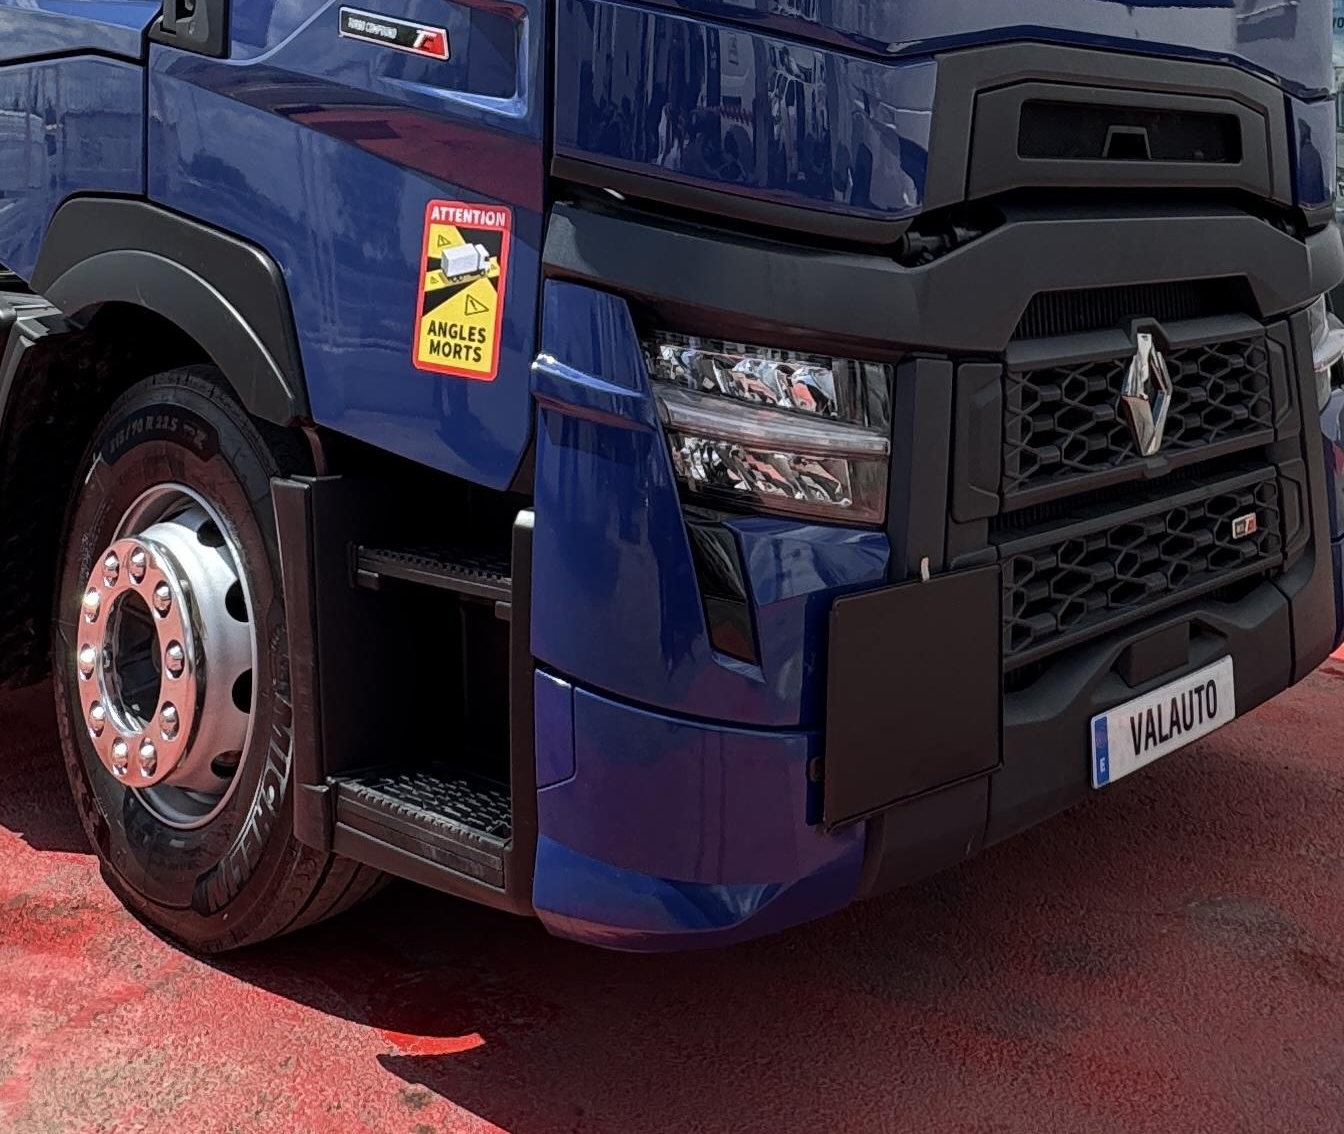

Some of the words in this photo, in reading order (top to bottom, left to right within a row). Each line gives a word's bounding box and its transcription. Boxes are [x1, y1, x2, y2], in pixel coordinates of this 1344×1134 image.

[431, 205, 506, 227] ATTENTION
[427, 319, 487, 345] ANGLES
[428, 338, 483, 363] MORTS
[1129, 679, 1218, 757] VALAUTO
